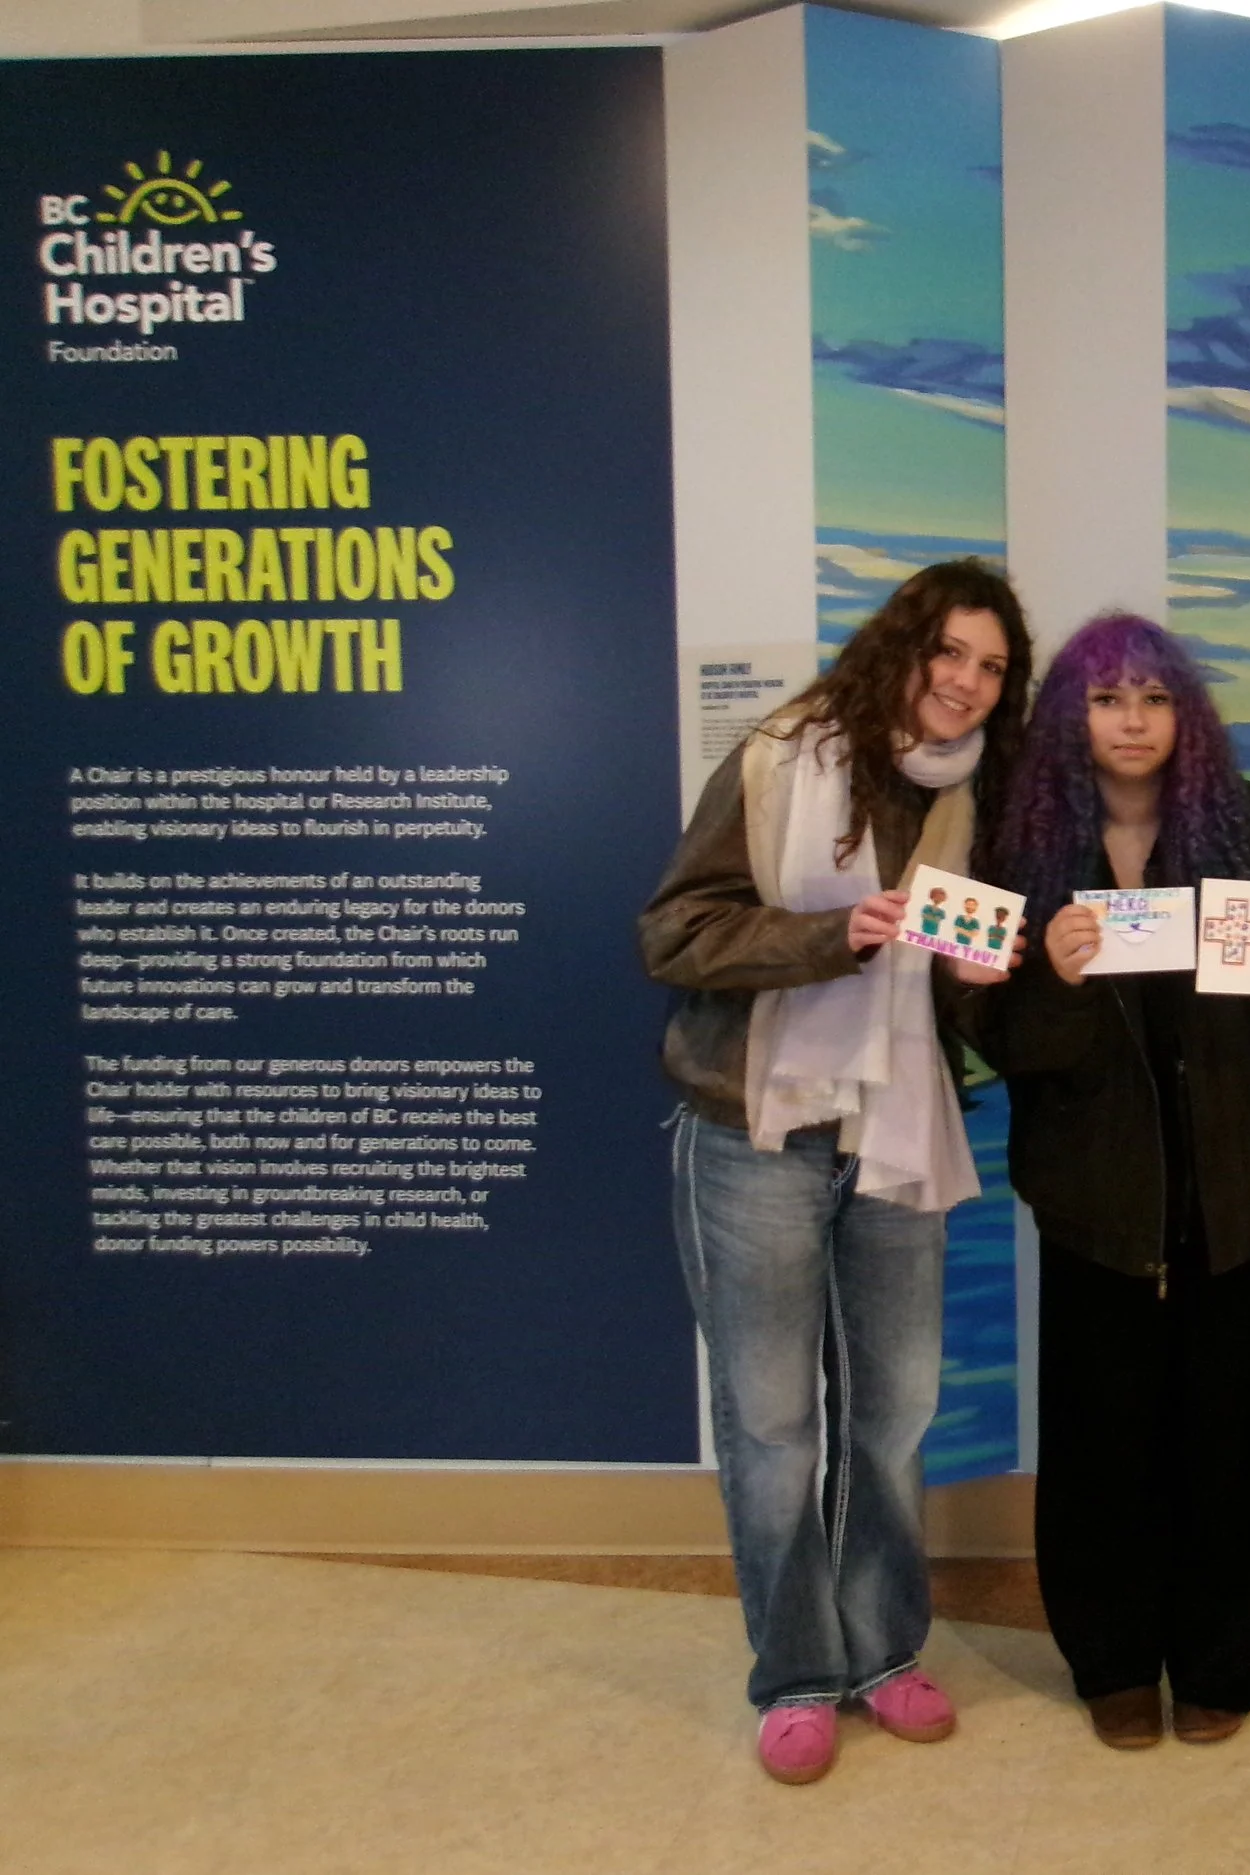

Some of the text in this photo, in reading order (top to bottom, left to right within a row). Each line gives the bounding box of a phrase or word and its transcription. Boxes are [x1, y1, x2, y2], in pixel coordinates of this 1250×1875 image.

[42, 195, 90, 225] BC
[40, 230, 276, 276] Children's
[45, 280, 244, 333] Hospital
[48, 341, 178, 364] Foundation
[52, 435, 370, 512] FOSTERING
[58, 526, 454, 603] GENERATIONS
[63, 618, 403, 696] OF GROWTH
[71, 764, 509, 786] A Chair is a prestigious honour held by a leadership
[72, 792, 493, 812] position within the hospital or Research Institute,
[72, 819, 487, 840] enabling visionary ideas to flourish in perpetuity.
[149, 877, 172, 888] on
[176, 873, 205, 888] the
[208, 873, 327, 889] achievements
[329, 872, 349, 889] of
[351, 876, 374, 888] an
[377, 872, 482, 892] outstanding
[76, 898, 525, 919] leader and creates an enduring legacy for the donors
[78, 926, 115, 941] who
[118, 925, 196, 941] establish
[222, 926, 268, 942] Once
[271, 925, 341, 943] created,
[344, 925, 375, 941] the
[440, 928, 485, 942] roots
[489, 929, 518, 942] run
[905, 930, 957, 955] THANK
[221, 955, 233, 967] a
[236, 954, 293, 972] strong
[294, 951, 387, 968] foundation
[391, 951, 433, 968] from
[436, 951, 486, 967] which
[81, 977, 474, 997] future innovations can grow and transform the
[82, 1003, 238, 1023] landscape of care.
[85, 1055, 534, 1076] The funding from our generous donors empowers the
[86, 1082, 542, 1103] Chair holder with resources to bring visionary ideas to
[206, 1108, 242, 1123] that
[246, 1108, 275, 1123] the
[279, 1108, 347, 1124] children
[351, 1108, 370, 1124] of
[372, 1109, 397, 1124] BC
[401, 1109, 462, 1124] receive
[466, 1109, 495, 1125] the
[499, 1109, 537, 1125] best
[89, 1133, 536, 1154] care possible, both now and for generations to come.
[90, 1159, 526, 1181] Whether that vision involves recruiting the brightest
[153, 1185, 230, 1204] investing
[232, 1189, 249, 1200] in
[252, 1185, 385, 1206] groundbreaking
[389, 1187, 466, 1204] research,
[470, 1191, 489, 1202] or
[93, 1210, 489, 1231] tackling the greatest challenges in child health,
[94, 1235, 372, 1256] donor funding powers possibility.
